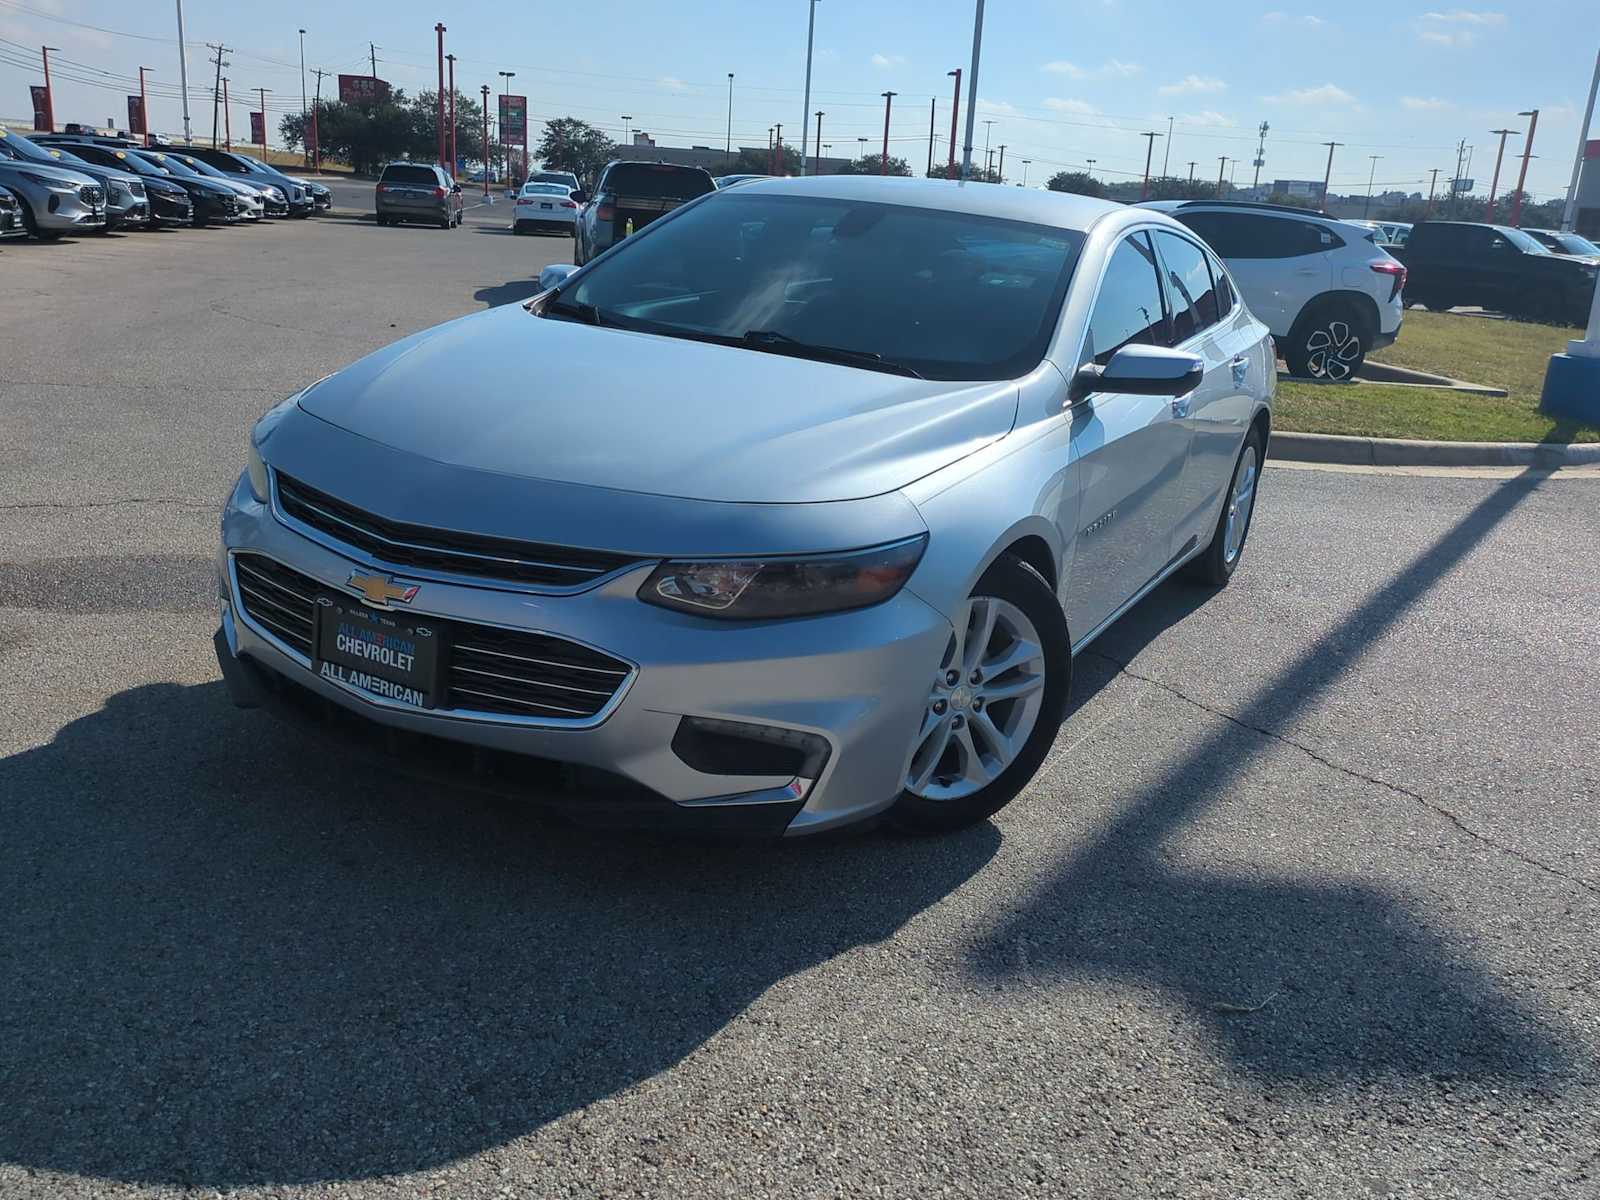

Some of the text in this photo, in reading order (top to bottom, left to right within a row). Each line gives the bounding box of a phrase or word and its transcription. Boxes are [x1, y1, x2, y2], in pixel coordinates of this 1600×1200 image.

[336, 634, 415, 673] CHEVROLET
[320, 661, 424, 707] ALL AMERICAN
